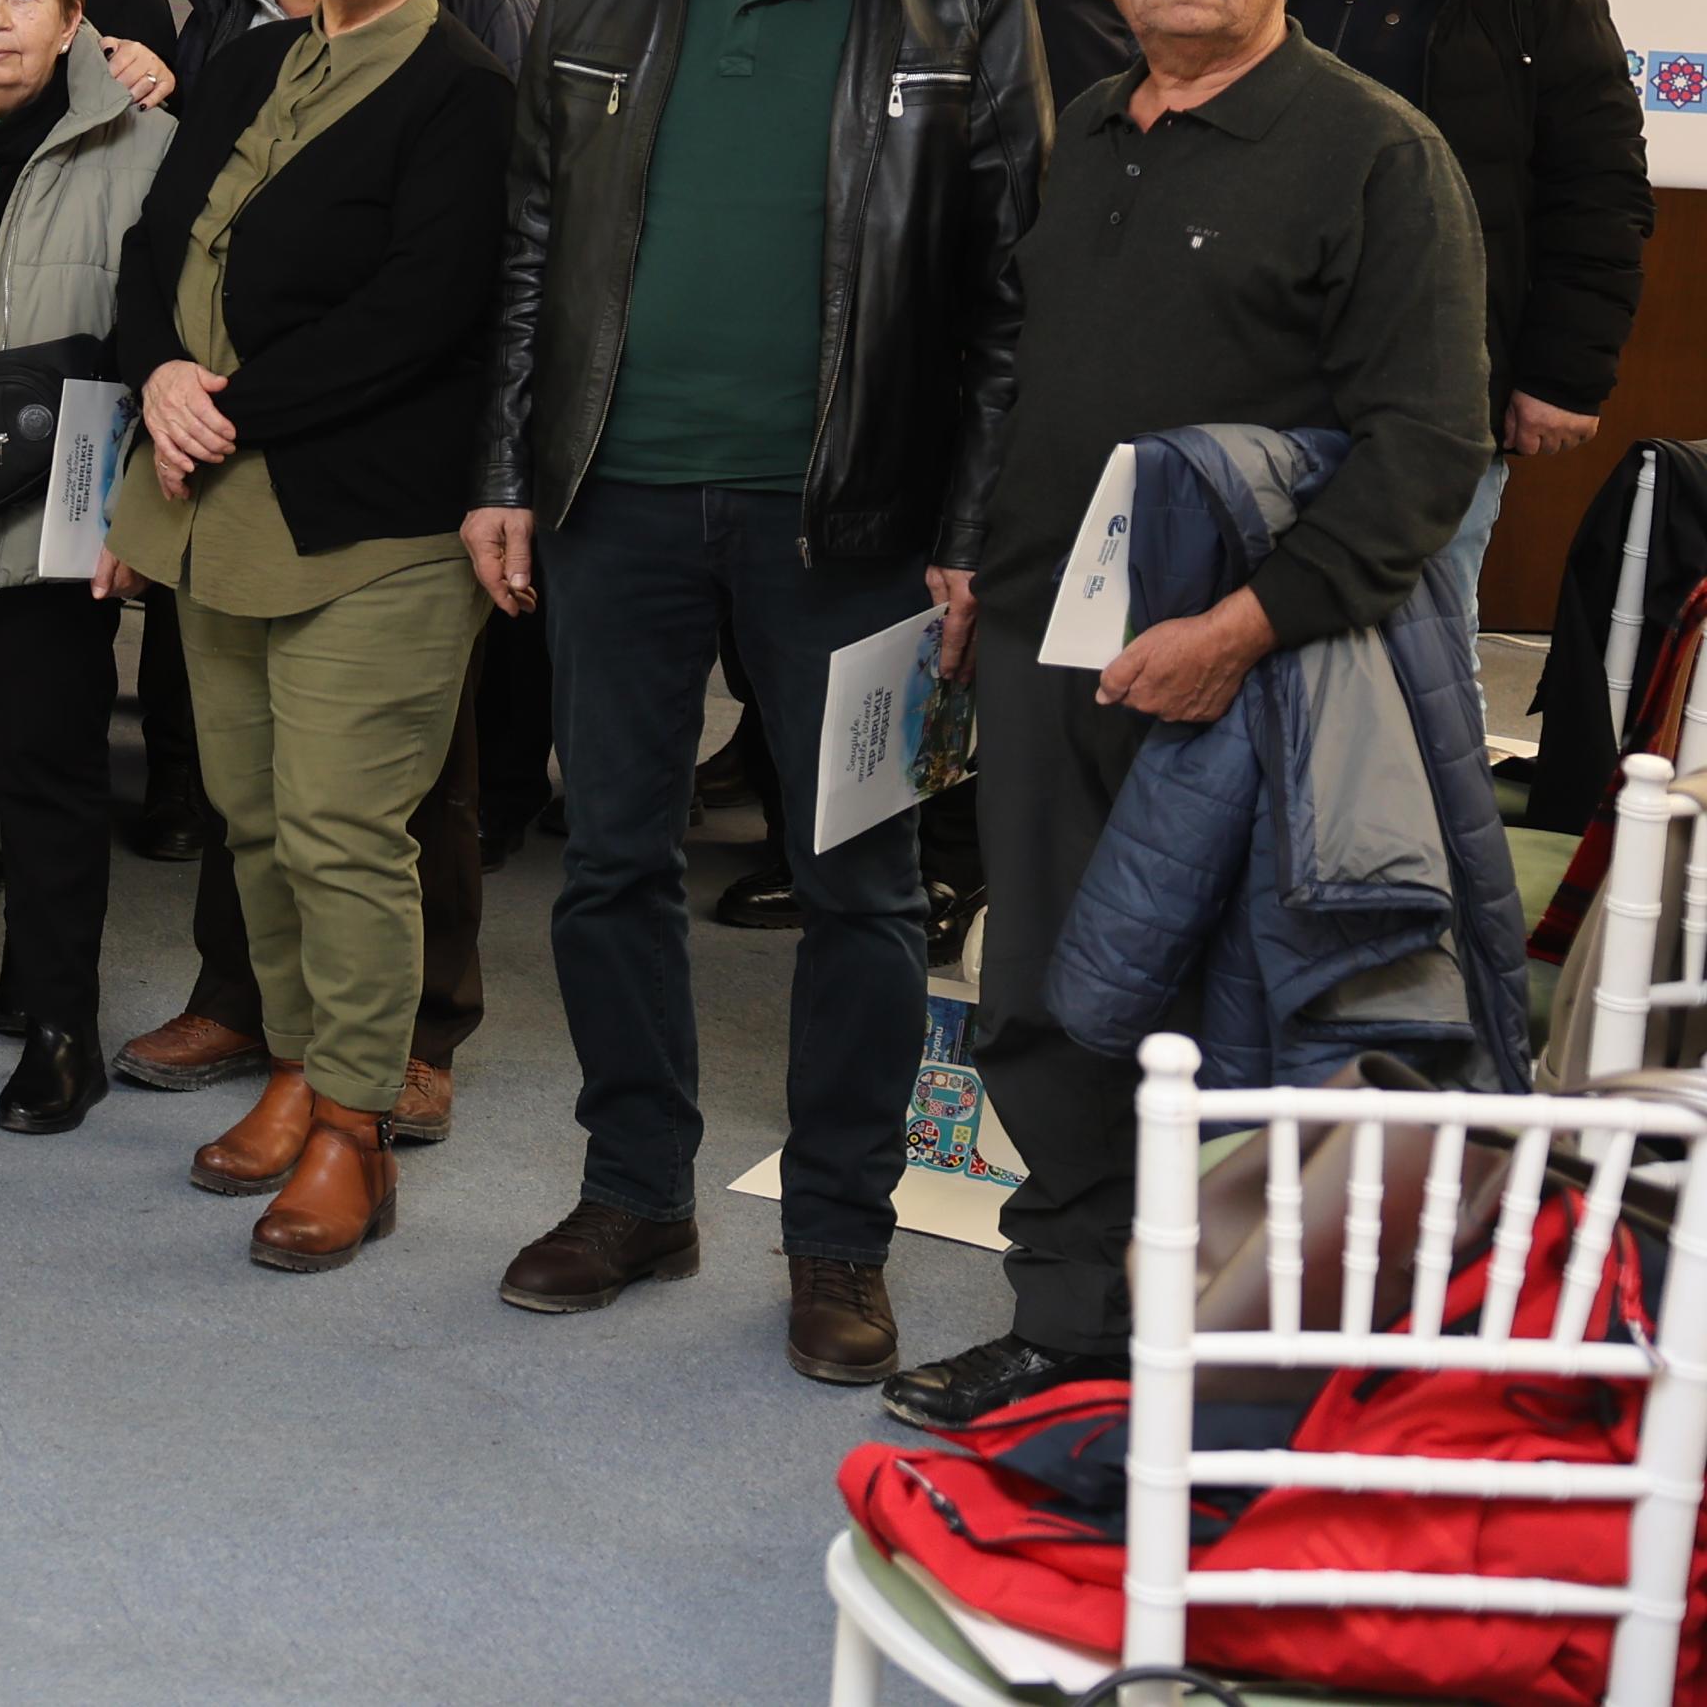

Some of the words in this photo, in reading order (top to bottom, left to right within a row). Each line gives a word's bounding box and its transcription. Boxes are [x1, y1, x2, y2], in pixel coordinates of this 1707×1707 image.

[75, 494, 83, 521] HEP
[877, 689, 893, 763] ESKİŞEHİR
[866, 748, 877, 778] HEP
